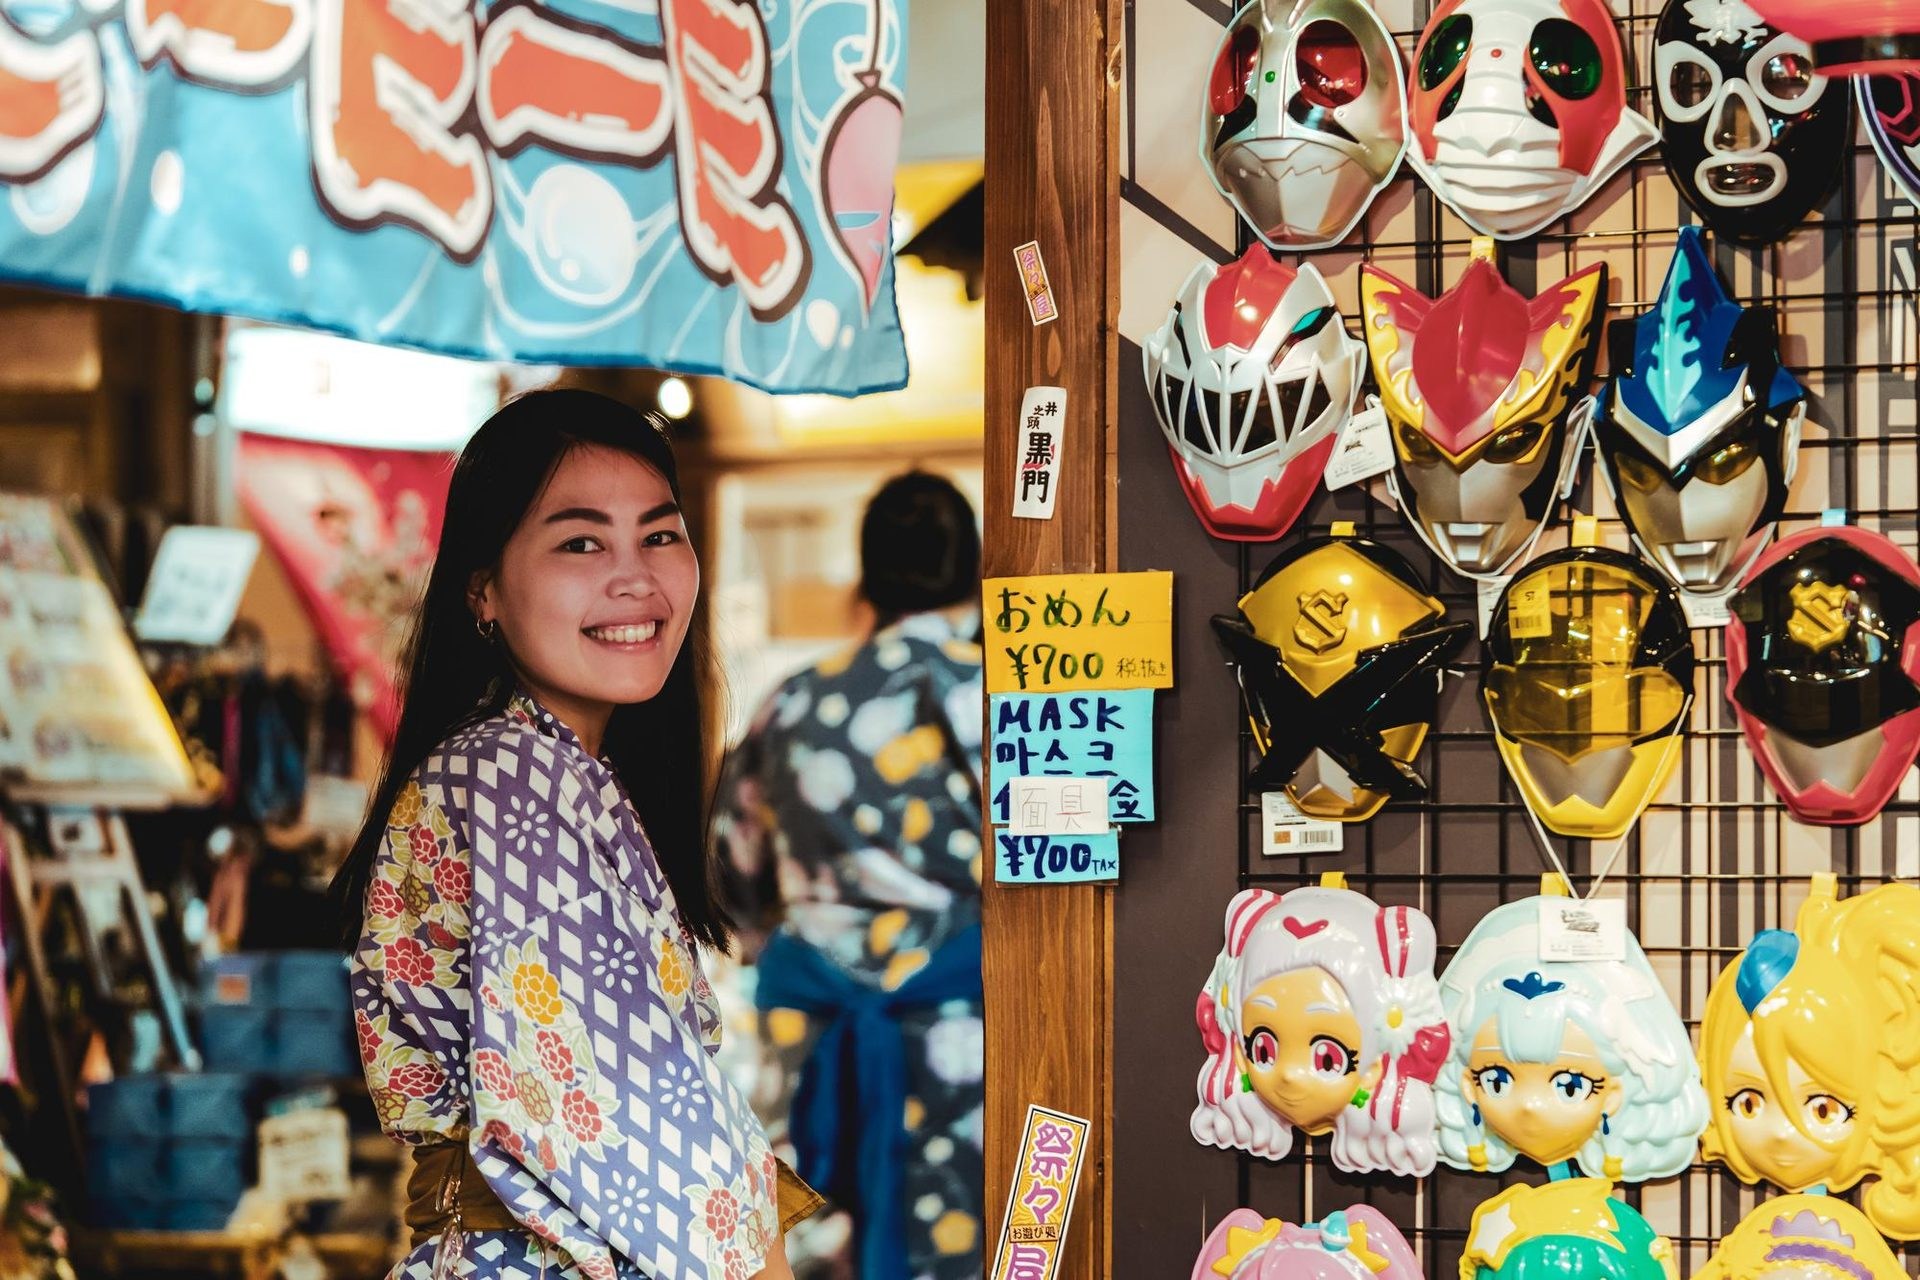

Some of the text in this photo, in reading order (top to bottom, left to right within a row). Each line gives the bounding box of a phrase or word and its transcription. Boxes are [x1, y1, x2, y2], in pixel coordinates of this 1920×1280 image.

[1022, 432, 1052, 503] 黒門
[996, 587, 1130, 633] おめん
[1006, 644, 1167, 690] ¥700 税抜き
[998, 697, 1124, 734] MASK
[996, 737, 1118, 776] 마스크
[1021, 784, 1092, 830] 面具
[998, 834, 1117, 879] ¥700 TAX
